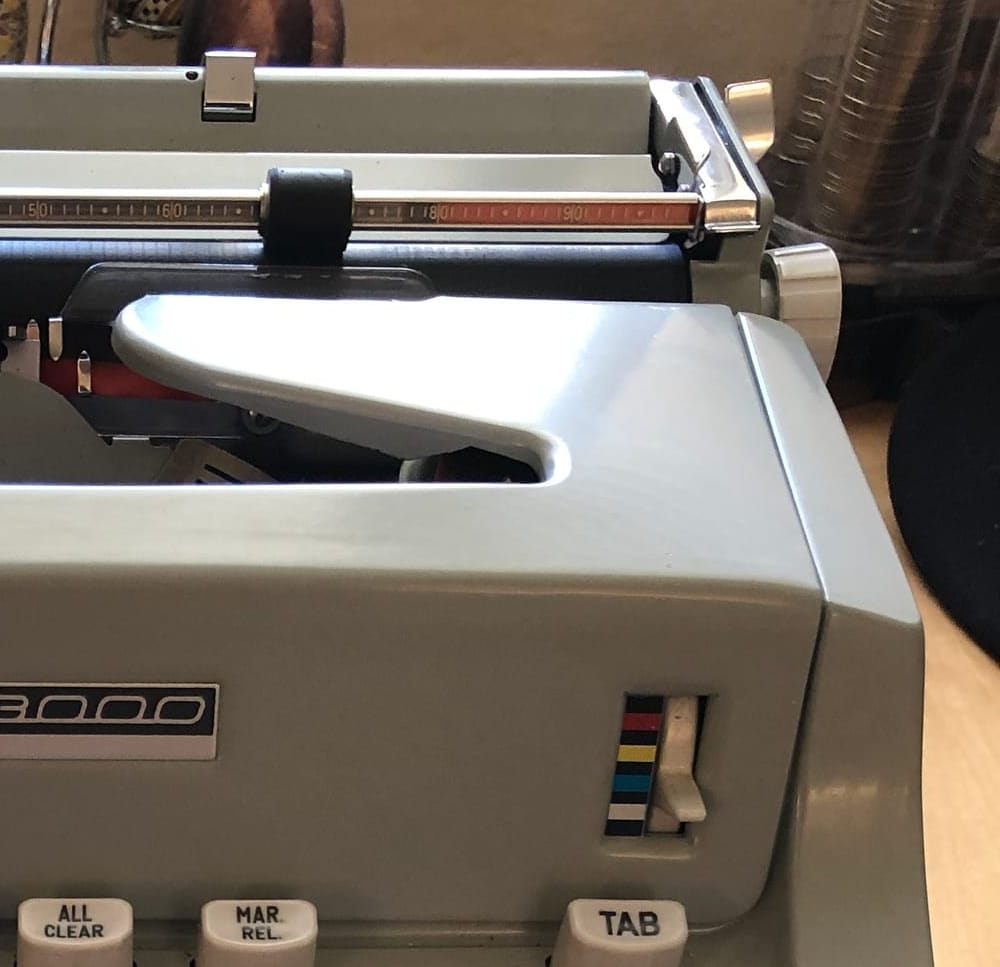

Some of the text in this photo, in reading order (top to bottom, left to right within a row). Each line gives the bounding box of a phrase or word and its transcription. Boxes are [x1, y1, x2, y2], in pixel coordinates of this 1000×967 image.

[28, 203, 48, 218] 50
[162, 203, 182, 218] 60
[57, 903, 93, 923] ALL
[43, 923, 104, 939] CLEAR
[598, 910, 661, 937] TAB
